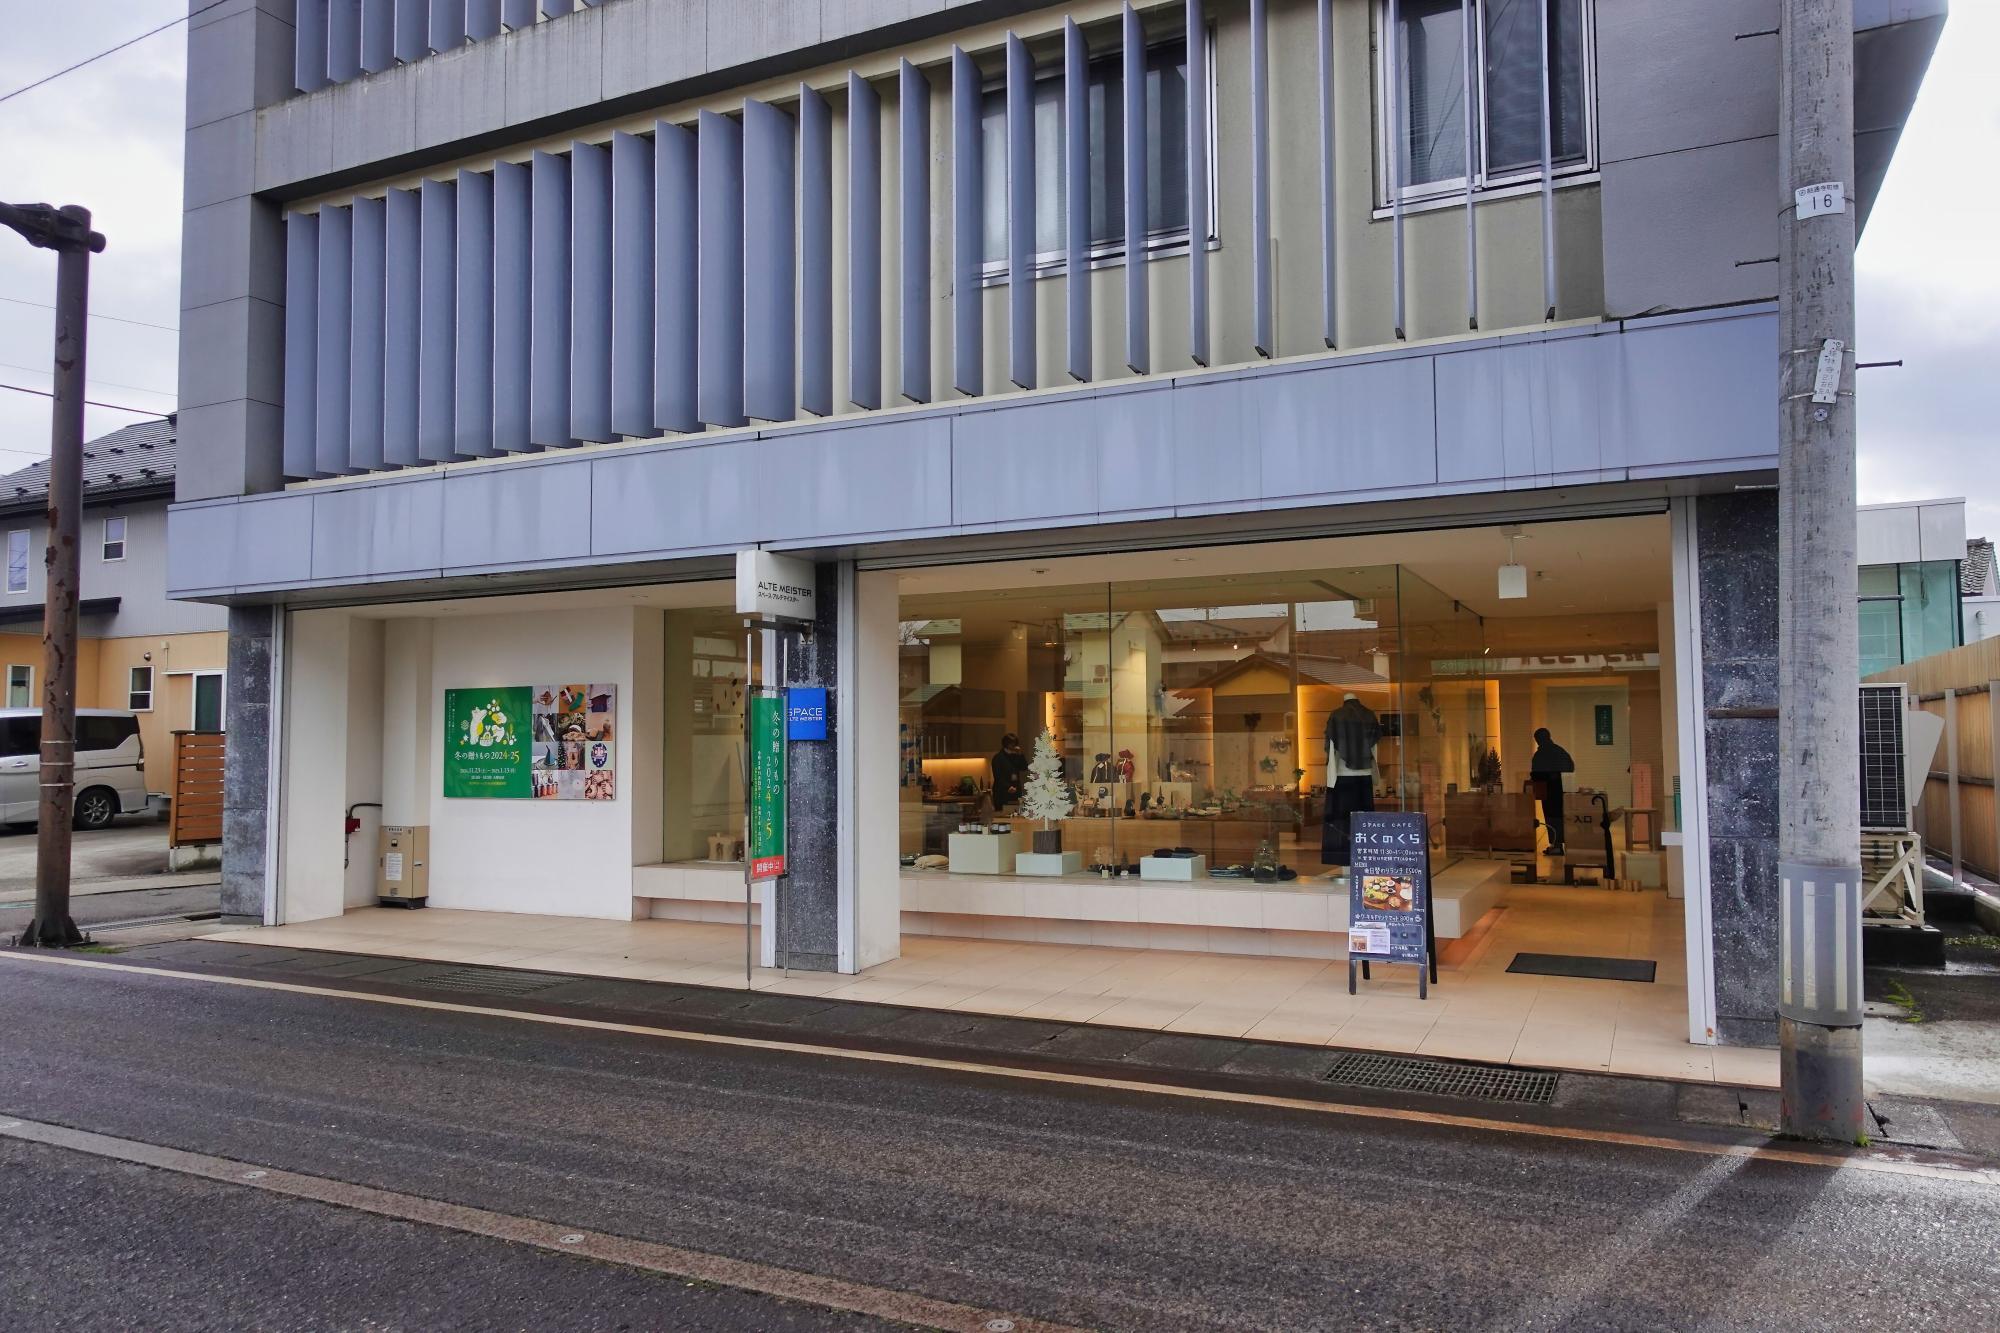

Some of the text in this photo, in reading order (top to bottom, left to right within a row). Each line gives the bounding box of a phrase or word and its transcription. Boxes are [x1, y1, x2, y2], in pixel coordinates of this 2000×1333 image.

[758, 581, 812, 598] ALTE MEISTER
[772, 710, 781, 795] 冬の贈りもの
[1574, 815, 1592, 824] 入口
[1355, 832, 1420, 844] おくのくら
